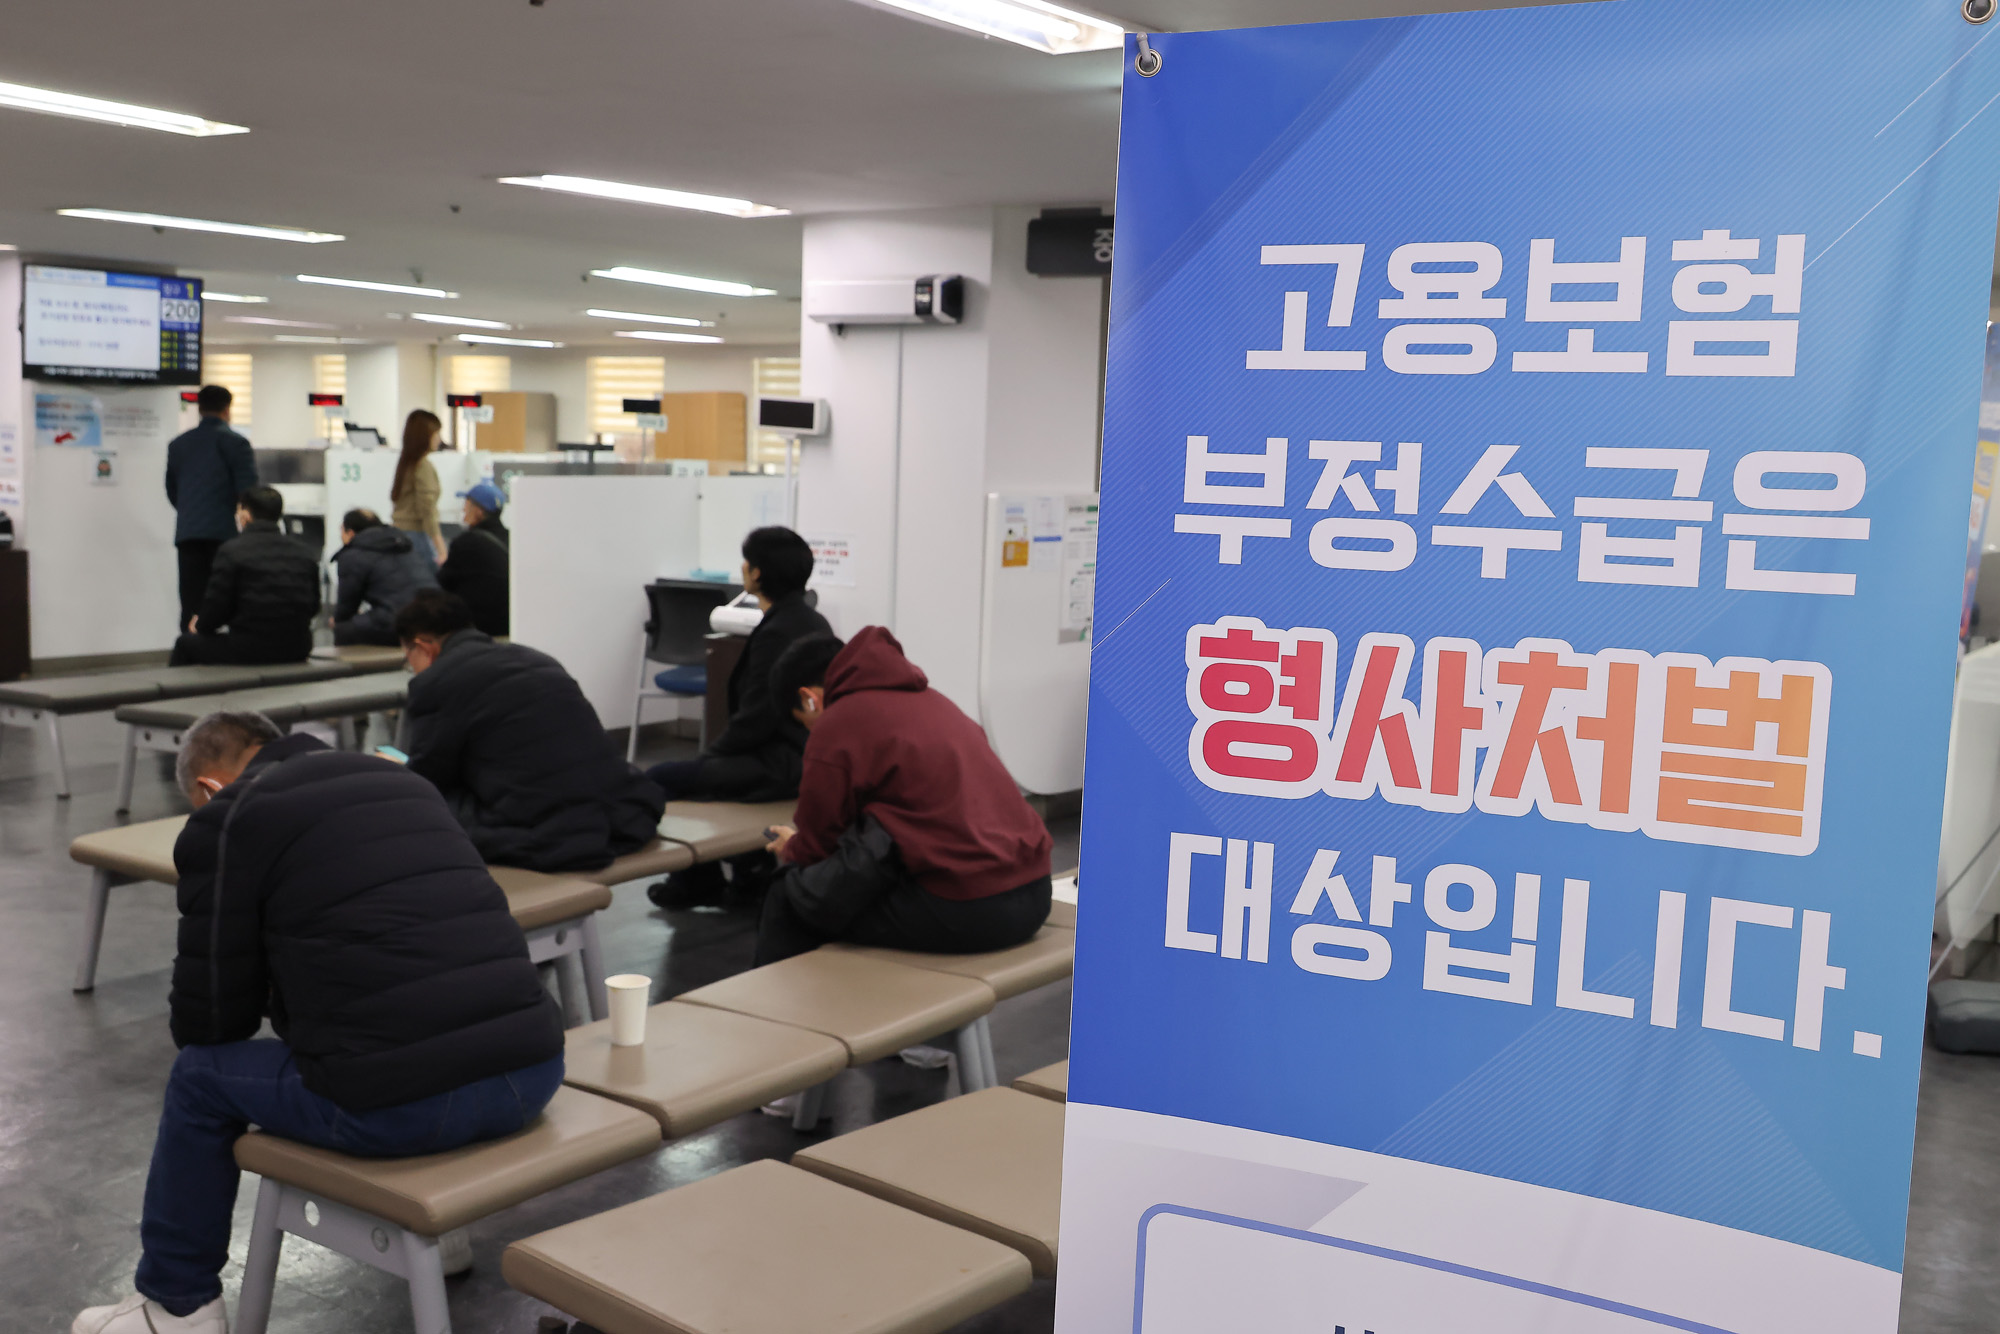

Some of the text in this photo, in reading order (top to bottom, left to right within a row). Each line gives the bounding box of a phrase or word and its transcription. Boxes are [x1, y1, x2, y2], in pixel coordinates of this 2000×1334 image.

[164, 302, 199, 321] 200
[1245, 228, 1807, 378] 고용보험
[341, 463, 361, 481] 33
[1173, 435, 1871, 596] 부정수급은
[1197, 627, 1816, 839] 형사처벌
[1164, 831, 1884, 1060] 대상입니다.
